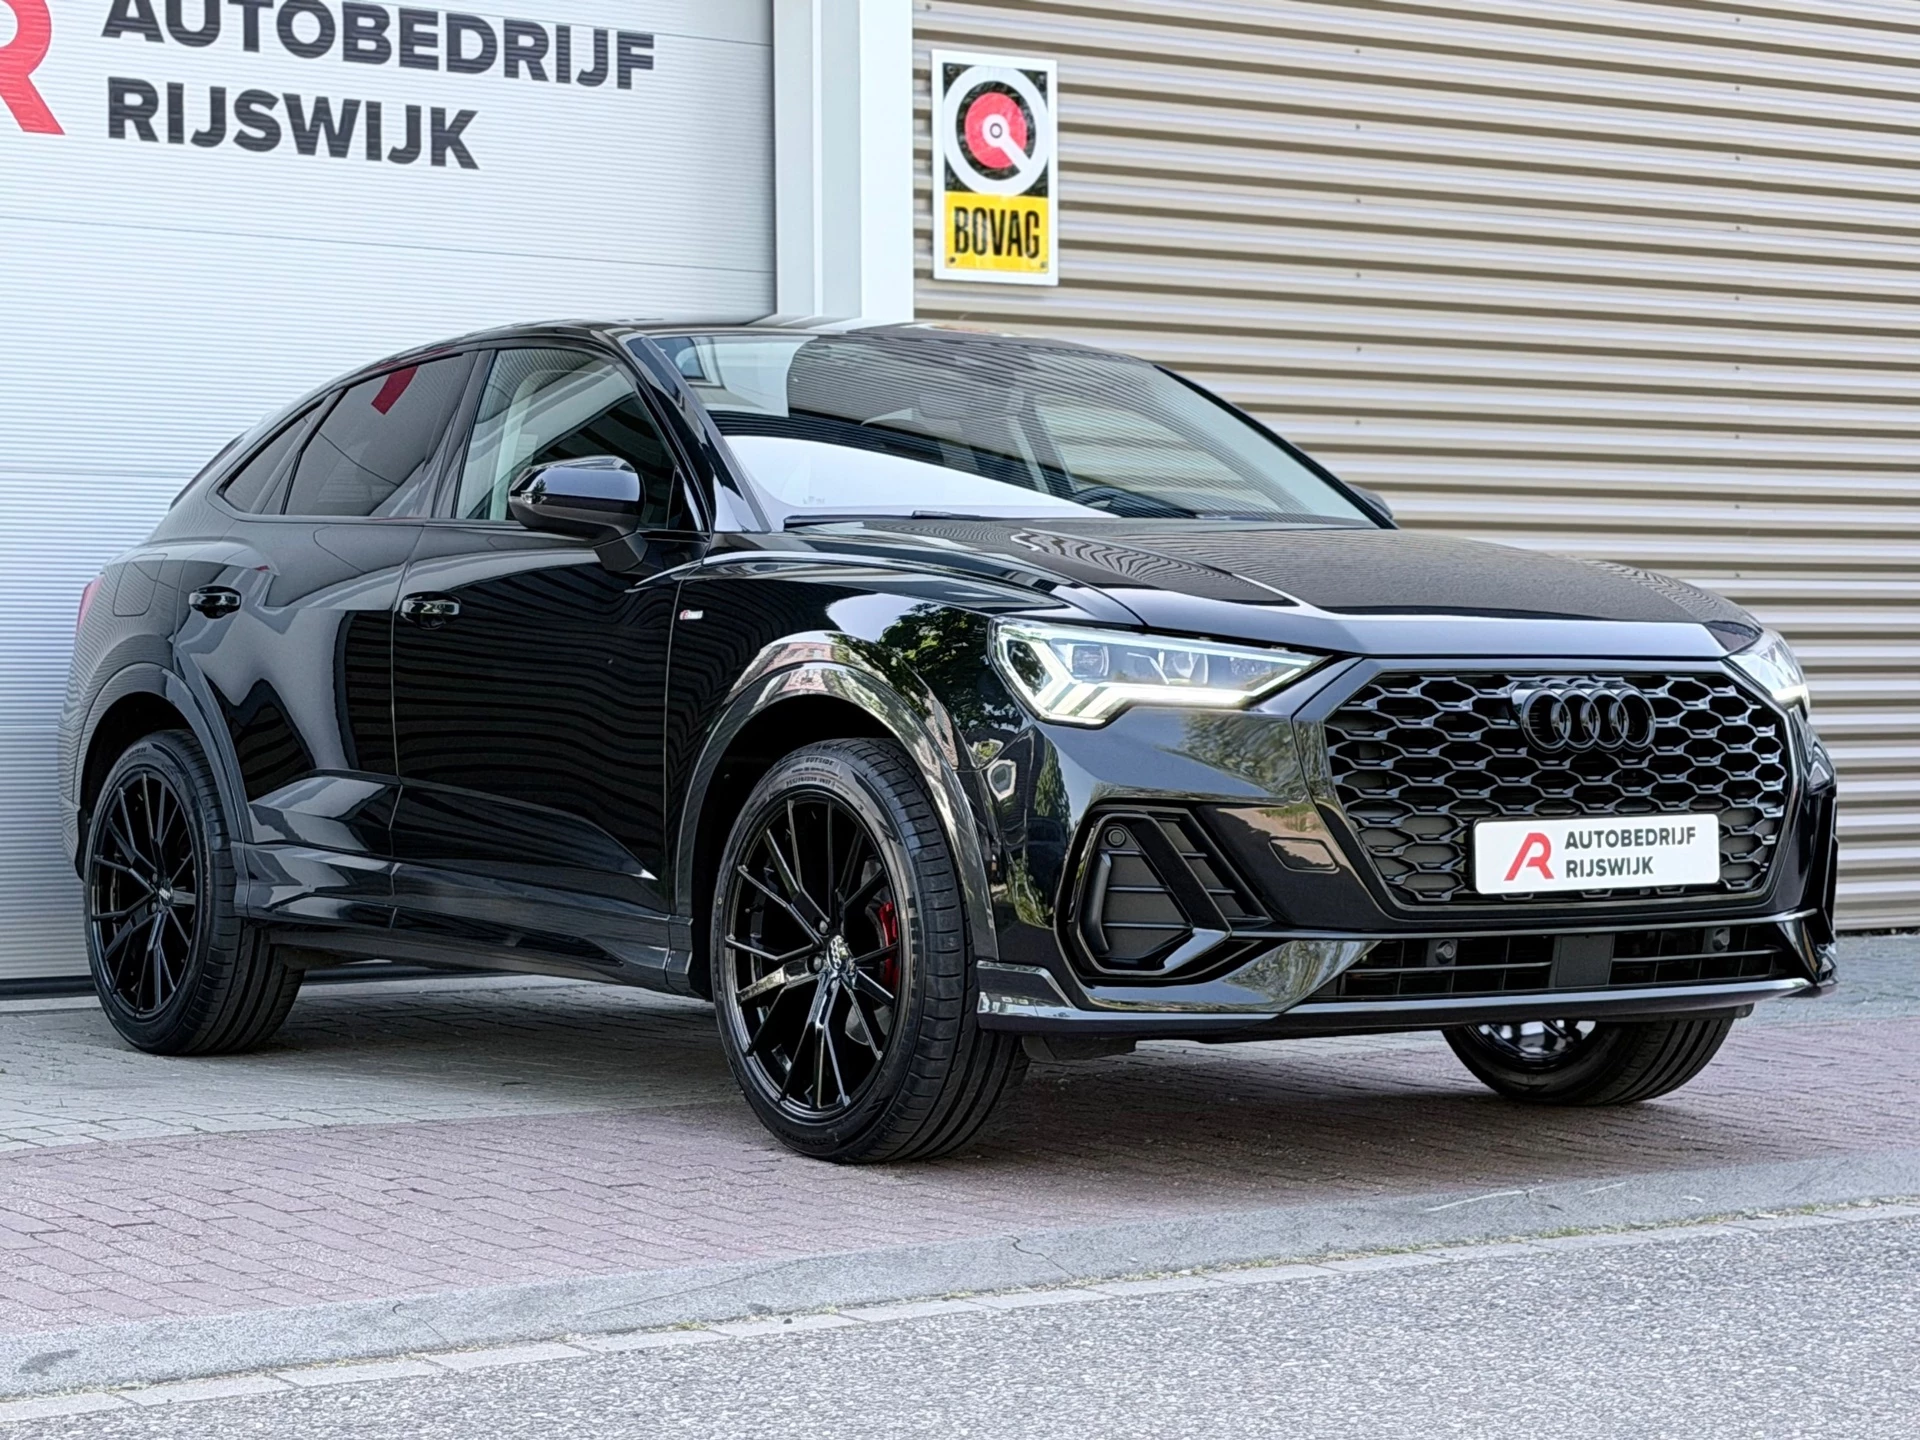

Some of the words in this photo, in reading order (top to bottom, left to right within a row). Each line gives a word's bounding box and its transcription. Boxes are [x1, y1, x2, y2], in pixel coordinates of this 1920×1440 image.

[102, 0, 655, 90] AUTOBEDRIJF
[107, 76, 480, 170] RIJSWIJK
[953, 206, 1040, 259] BOVAG
[1564, 826, 1697, 850] AUTOBEDRIJF
[1565, 856, 1654, 878] RIJSWIJK
